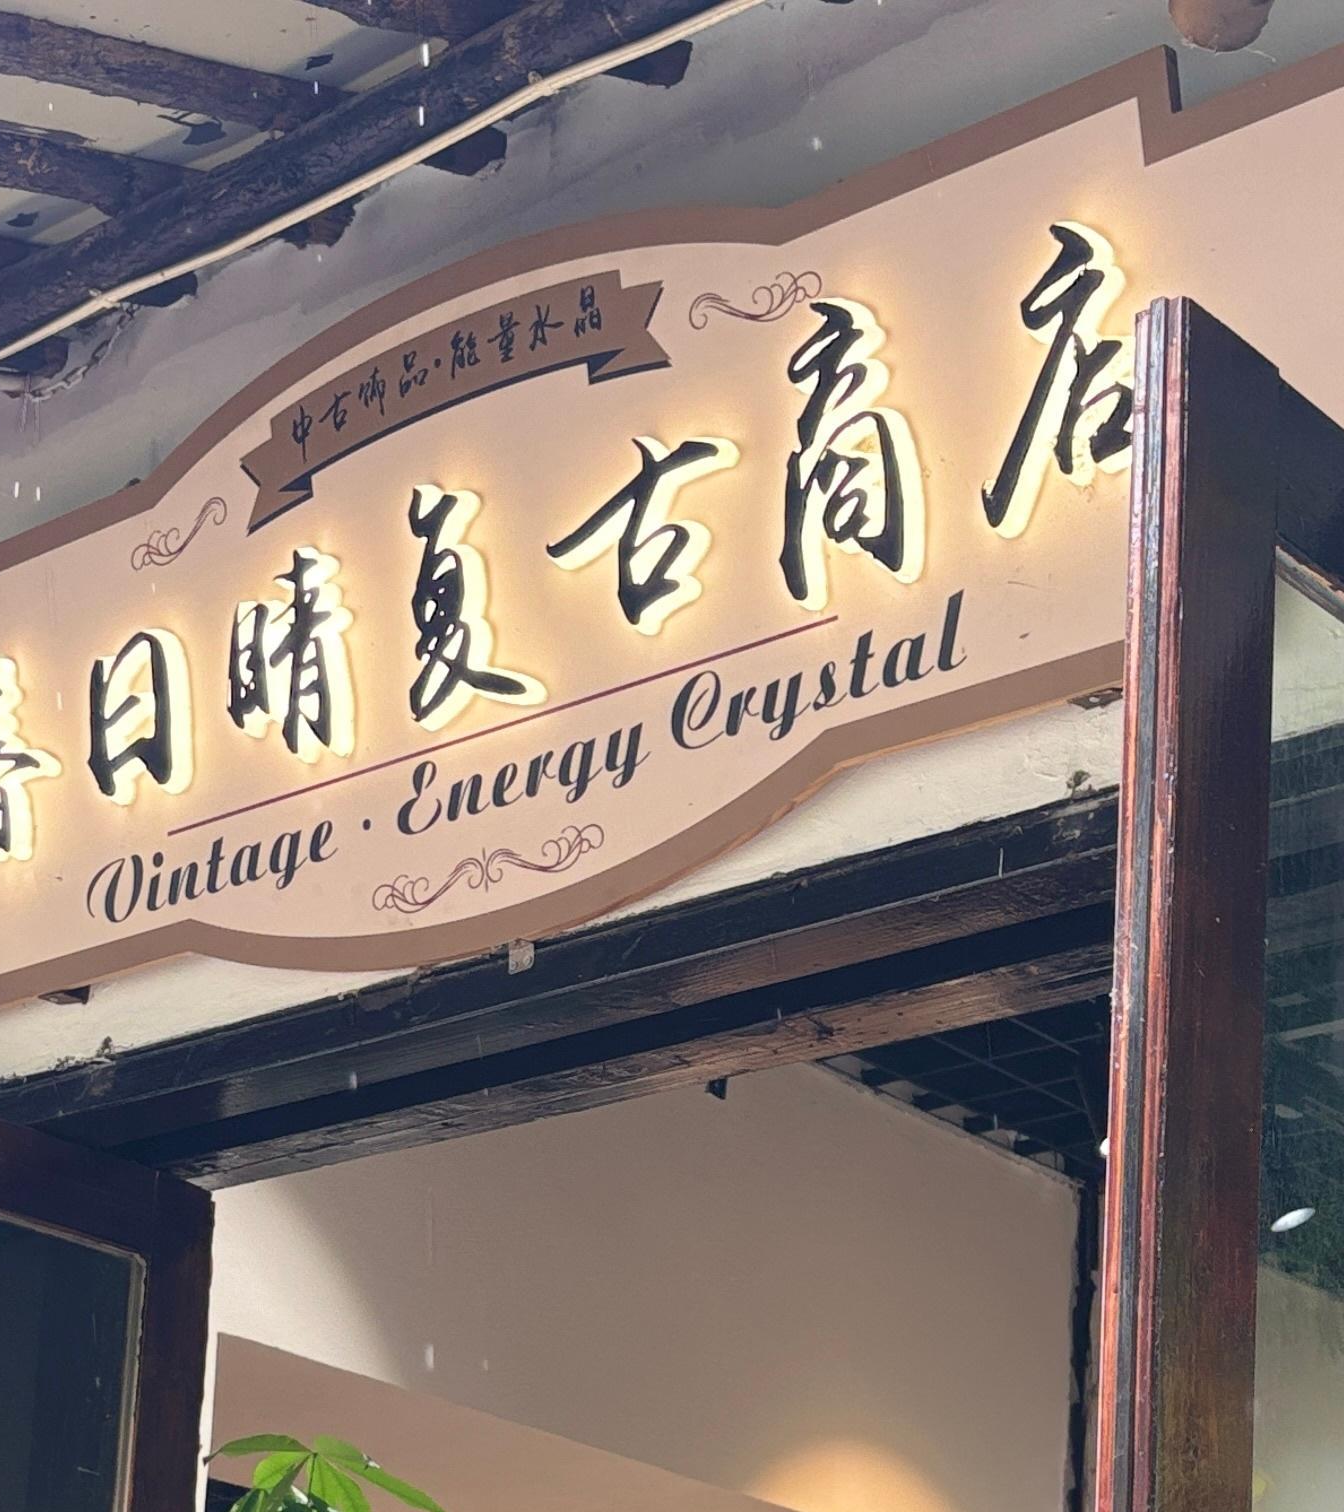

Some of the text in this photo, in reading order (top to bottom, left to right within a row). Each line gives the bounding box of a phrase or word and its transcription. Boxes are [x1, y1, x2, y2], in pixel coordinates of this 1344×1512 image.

[86, 820, 338, 923] Vintage
[397, 721, 650, 835] Energy
[671, 589, 967, 751] Crystal
